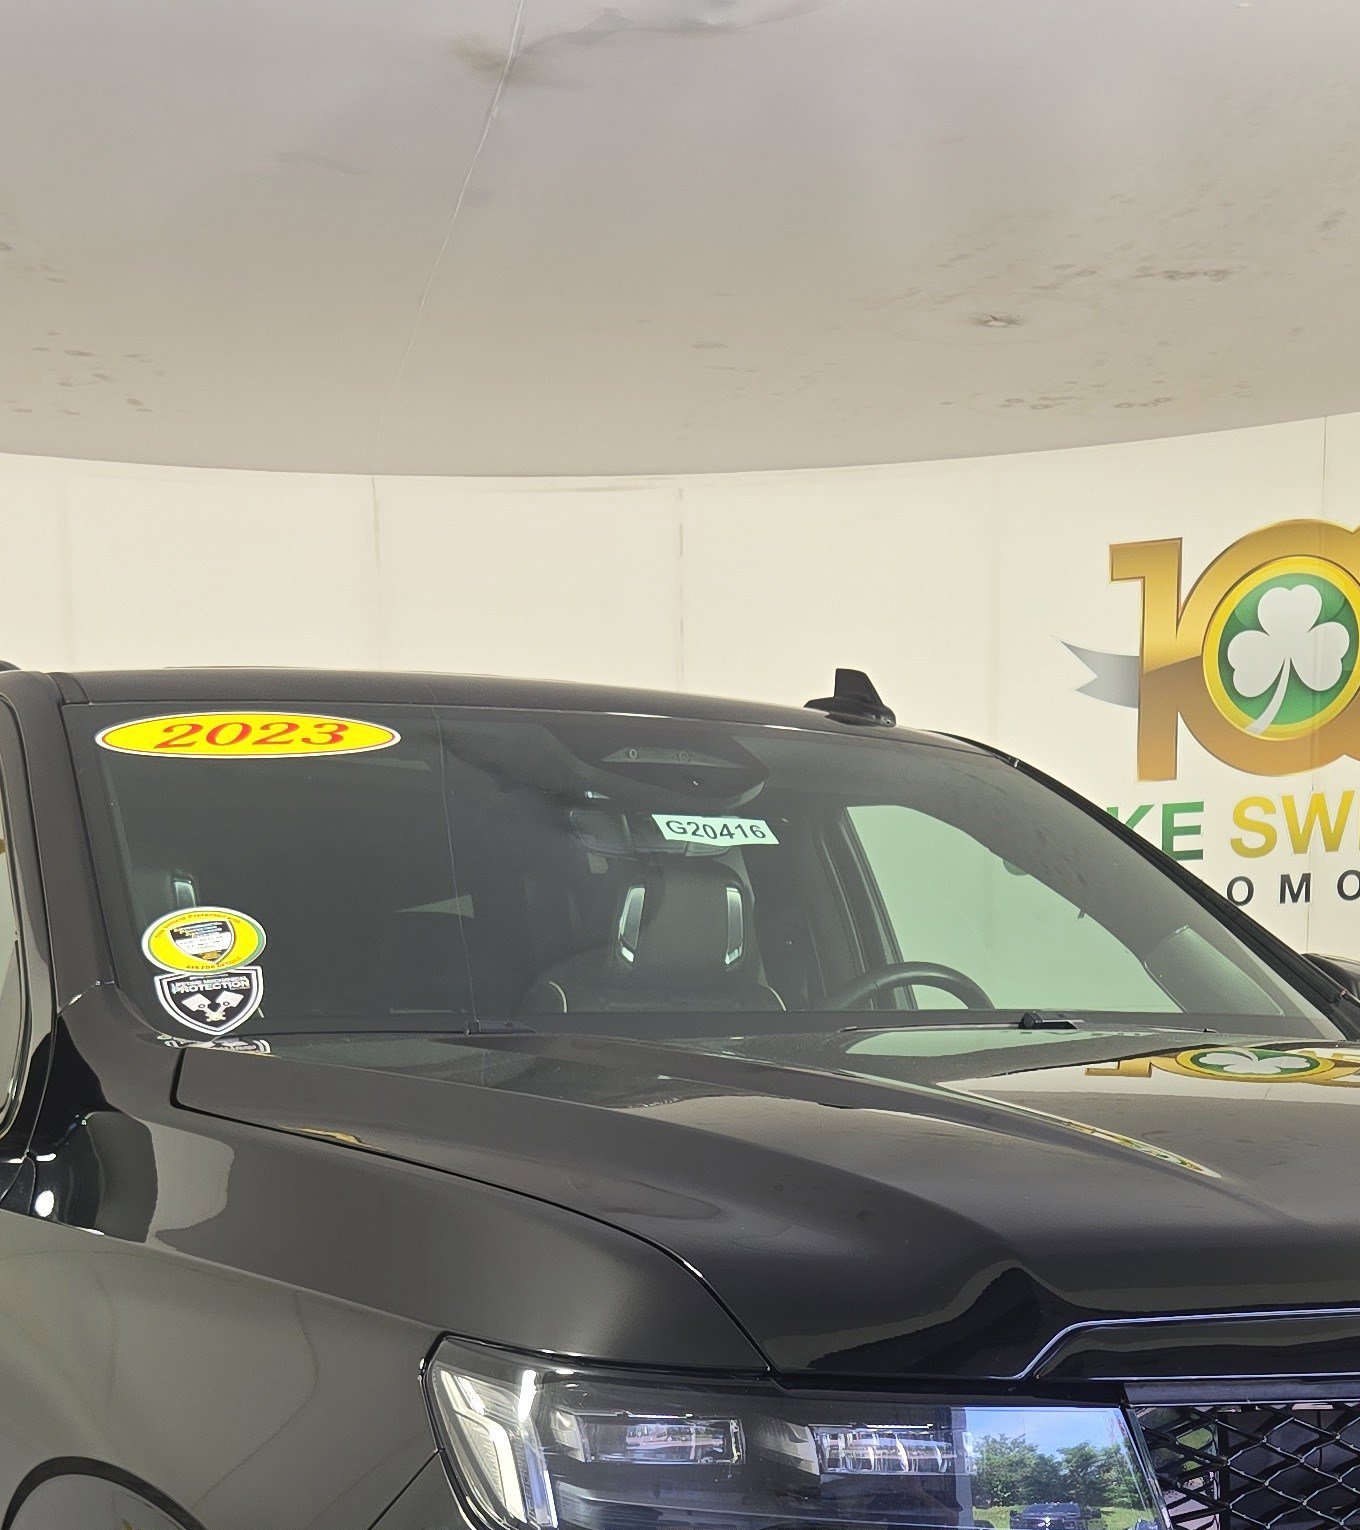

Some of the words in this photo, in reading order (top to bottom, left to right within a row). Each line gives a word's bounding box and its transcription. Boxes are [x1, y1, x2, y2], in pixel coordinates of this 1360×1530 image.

[153, 721, 349, 749] 2023
[665, 819, 767, 841] G20416
[171, 979, 250, 994] PROTECTION
